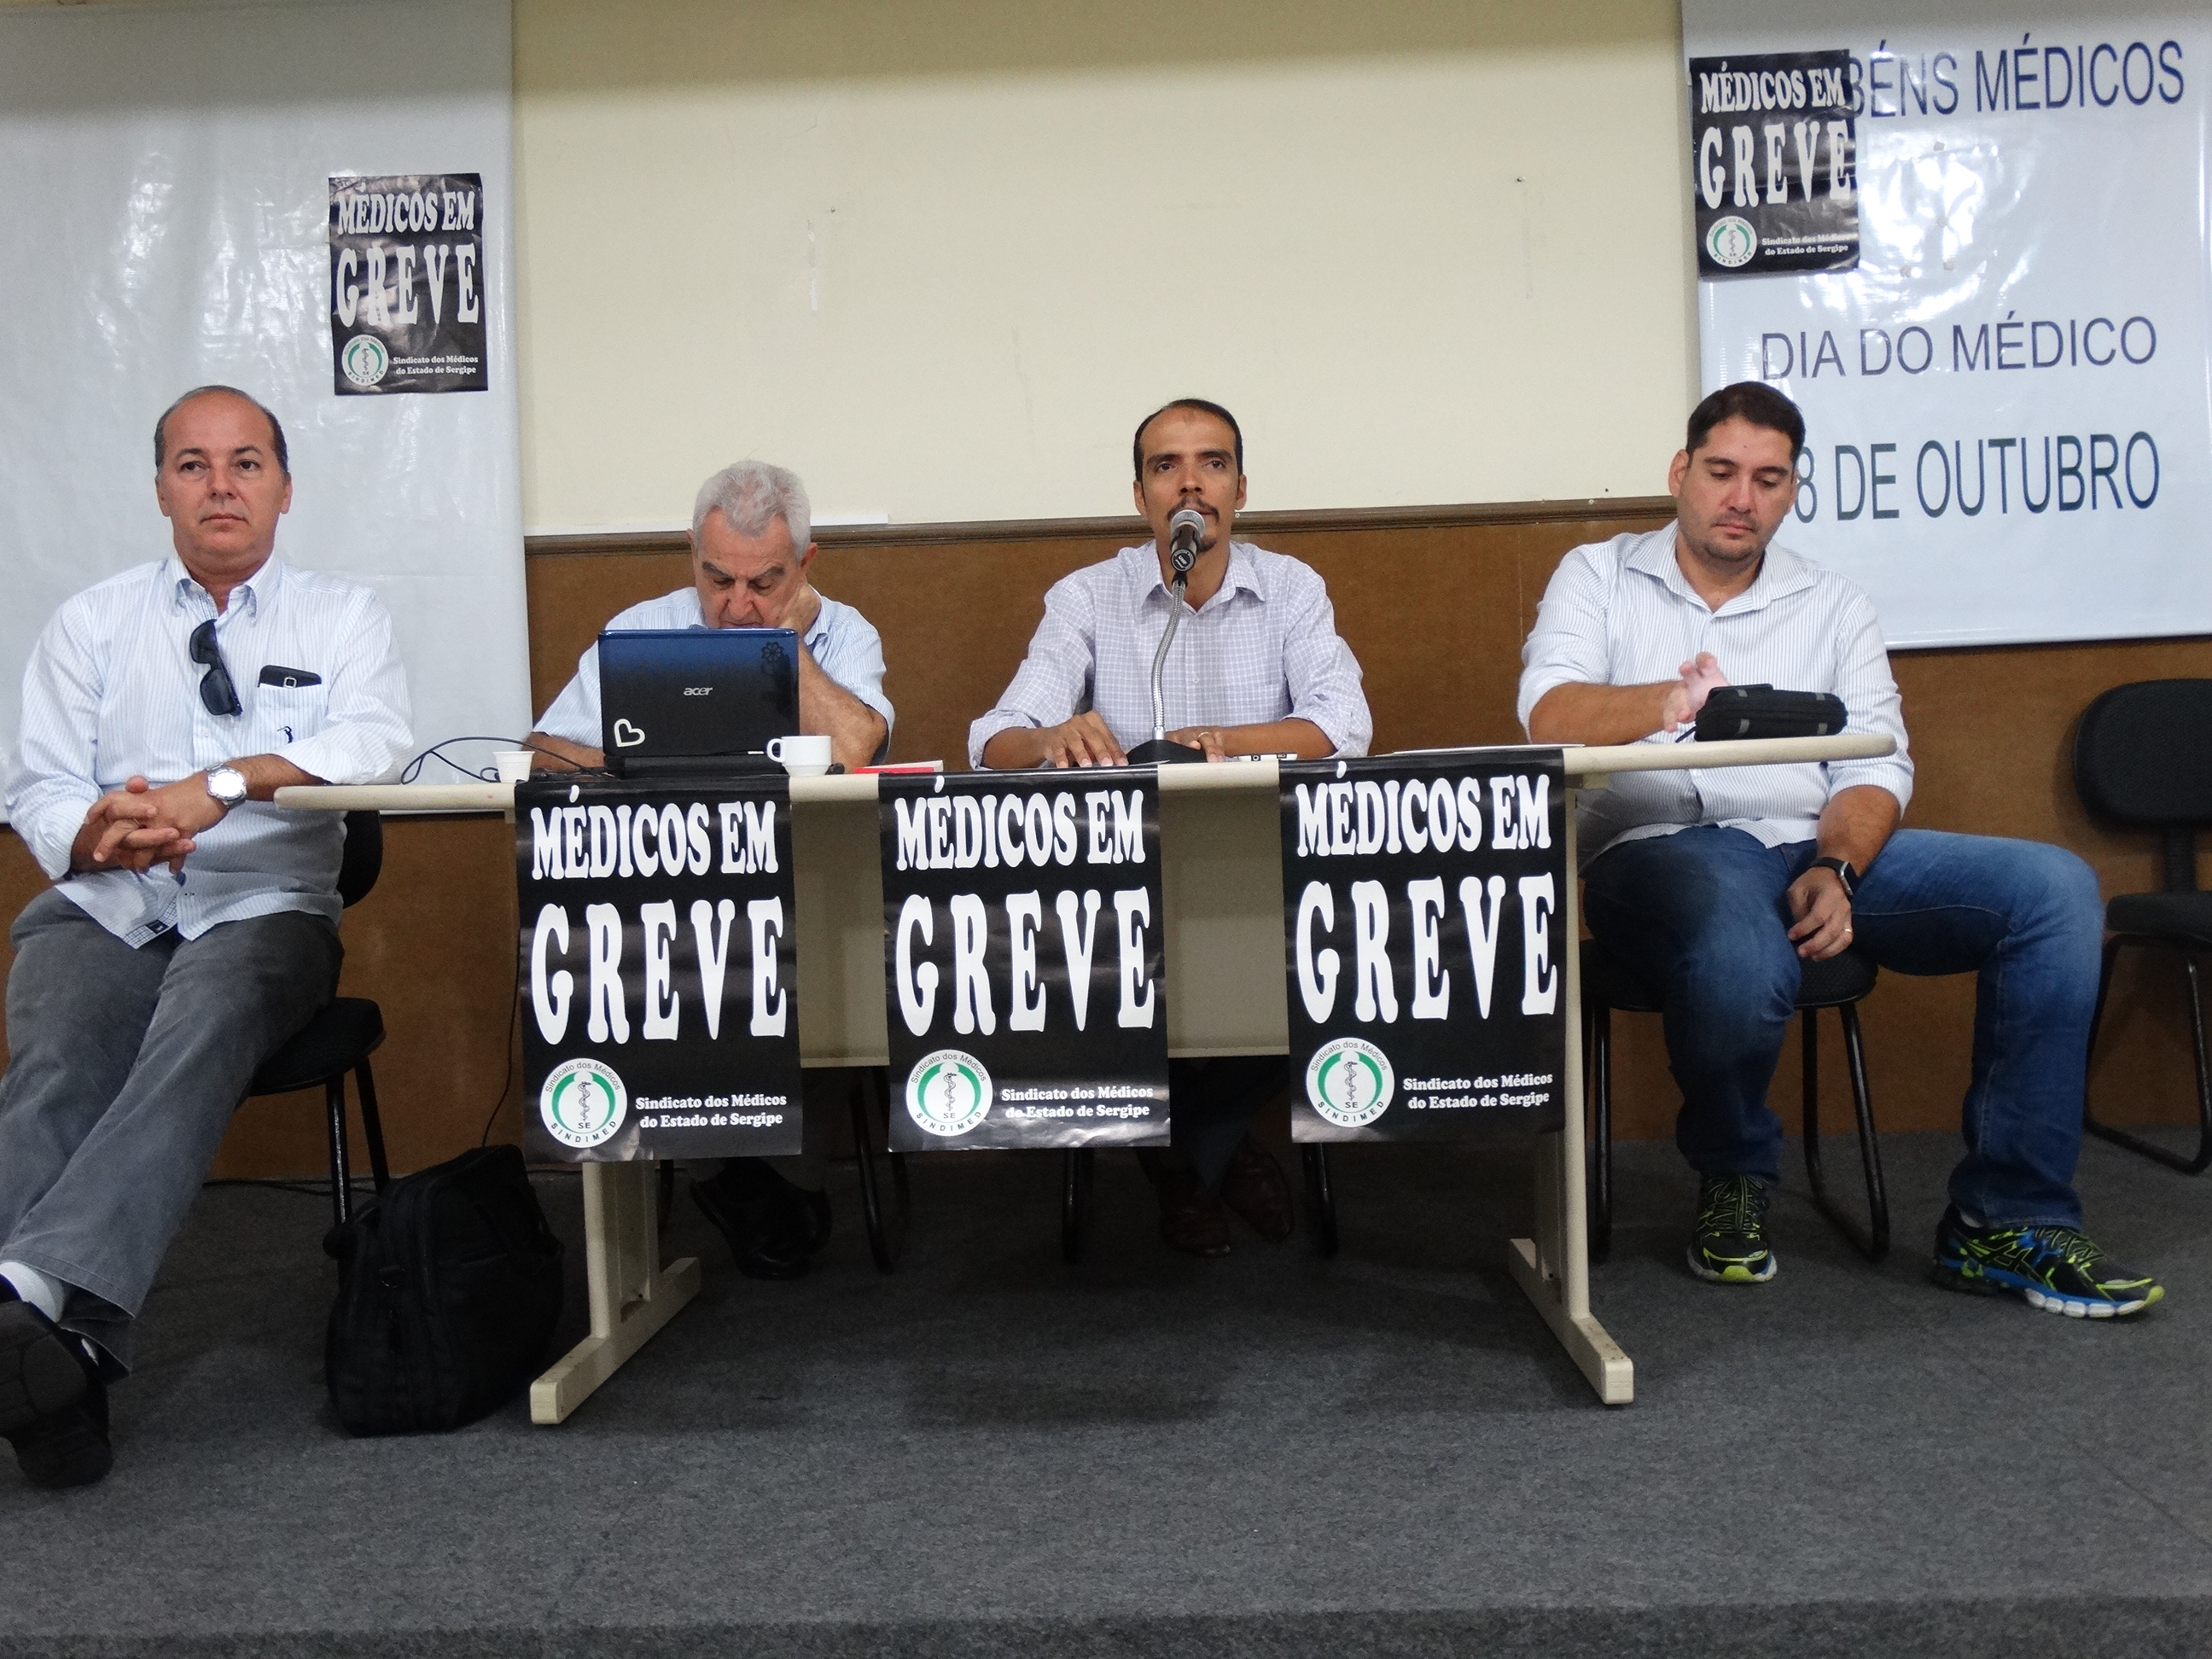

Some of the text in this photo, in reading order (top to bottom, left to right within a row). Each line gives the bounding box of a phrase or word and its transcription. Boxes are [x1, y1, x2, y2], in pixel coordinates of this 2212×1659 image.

[1975, 32, 2185, 113] MÉDICOS
[1700, 61, 1846, 114] MÉDICOS EM
[1700, 119, 1851, 209] GREVE
[337, 182, 475, 235] MÉDICOS EM
[1761, 237, 1801, 246] Sindicato
[1802, 236, 1816, 244] dos
[1765, 247, 1775, 256] do
[1777, 246, 1806, 255] Estado
[1817, 244, 1849, 254] Sergipe
[336, 243, 480, 328] GREVE
[393, 356, 430, 364] Sindicato
[446, 355, 479, 364] Médicos
[1762, 311, 2157, 381] DIA DO MÉDICO
[407, 366, 434, 375] Estado
[445, 365, 477, 375] Sergipe
[1835, 443, 1900, 521] DE
[1917, 431, 2160, 518] OUTUBRO
[684, 686, 713, 696] acer
[894, 775, 1146, 870] MÉDICOS EM
[1295, 760, 1551, 857] MÉDICOS EM
[531, 785, 778, 880] MÉDICOS EM
[896, 887, 1155, 1036] GREVE
[1296, 872, 1557, 1023] GREVE
[531, 896, 787, 1045] GREVE
[911, 1056, 940, 1084] Sindicato
[960, 1055, 987, 1082] Médicos
[1311, 1044, 1341, 1072] Sindicato
[1360, 1043, 1388, 1071] Médicos
[545, 1064, 574, 1092] Sindicato
[594, 1063, 621, 1091] Médicos
[1403, 1074, 1553, 1091] Sindicato dos Médicos
[636, 1094, 787, 1109] Sindicato dos Médicos
[1001, 1086, 1154, 1101] Sindicato dos Médicos
[1408, 1091, 1550, 1109] do Estado de Sergipe
[640, 1112, 783, 1128] do Estado de Sergipe
[916, 1111, 981, 1132] SINDIMED
[1005, 1104, 1150, 1119] do Estado de Sergipe
[1318, 1101, 1383, 1122] SINDIMED
[551, 1121, 616, 1143] SINDIMED
